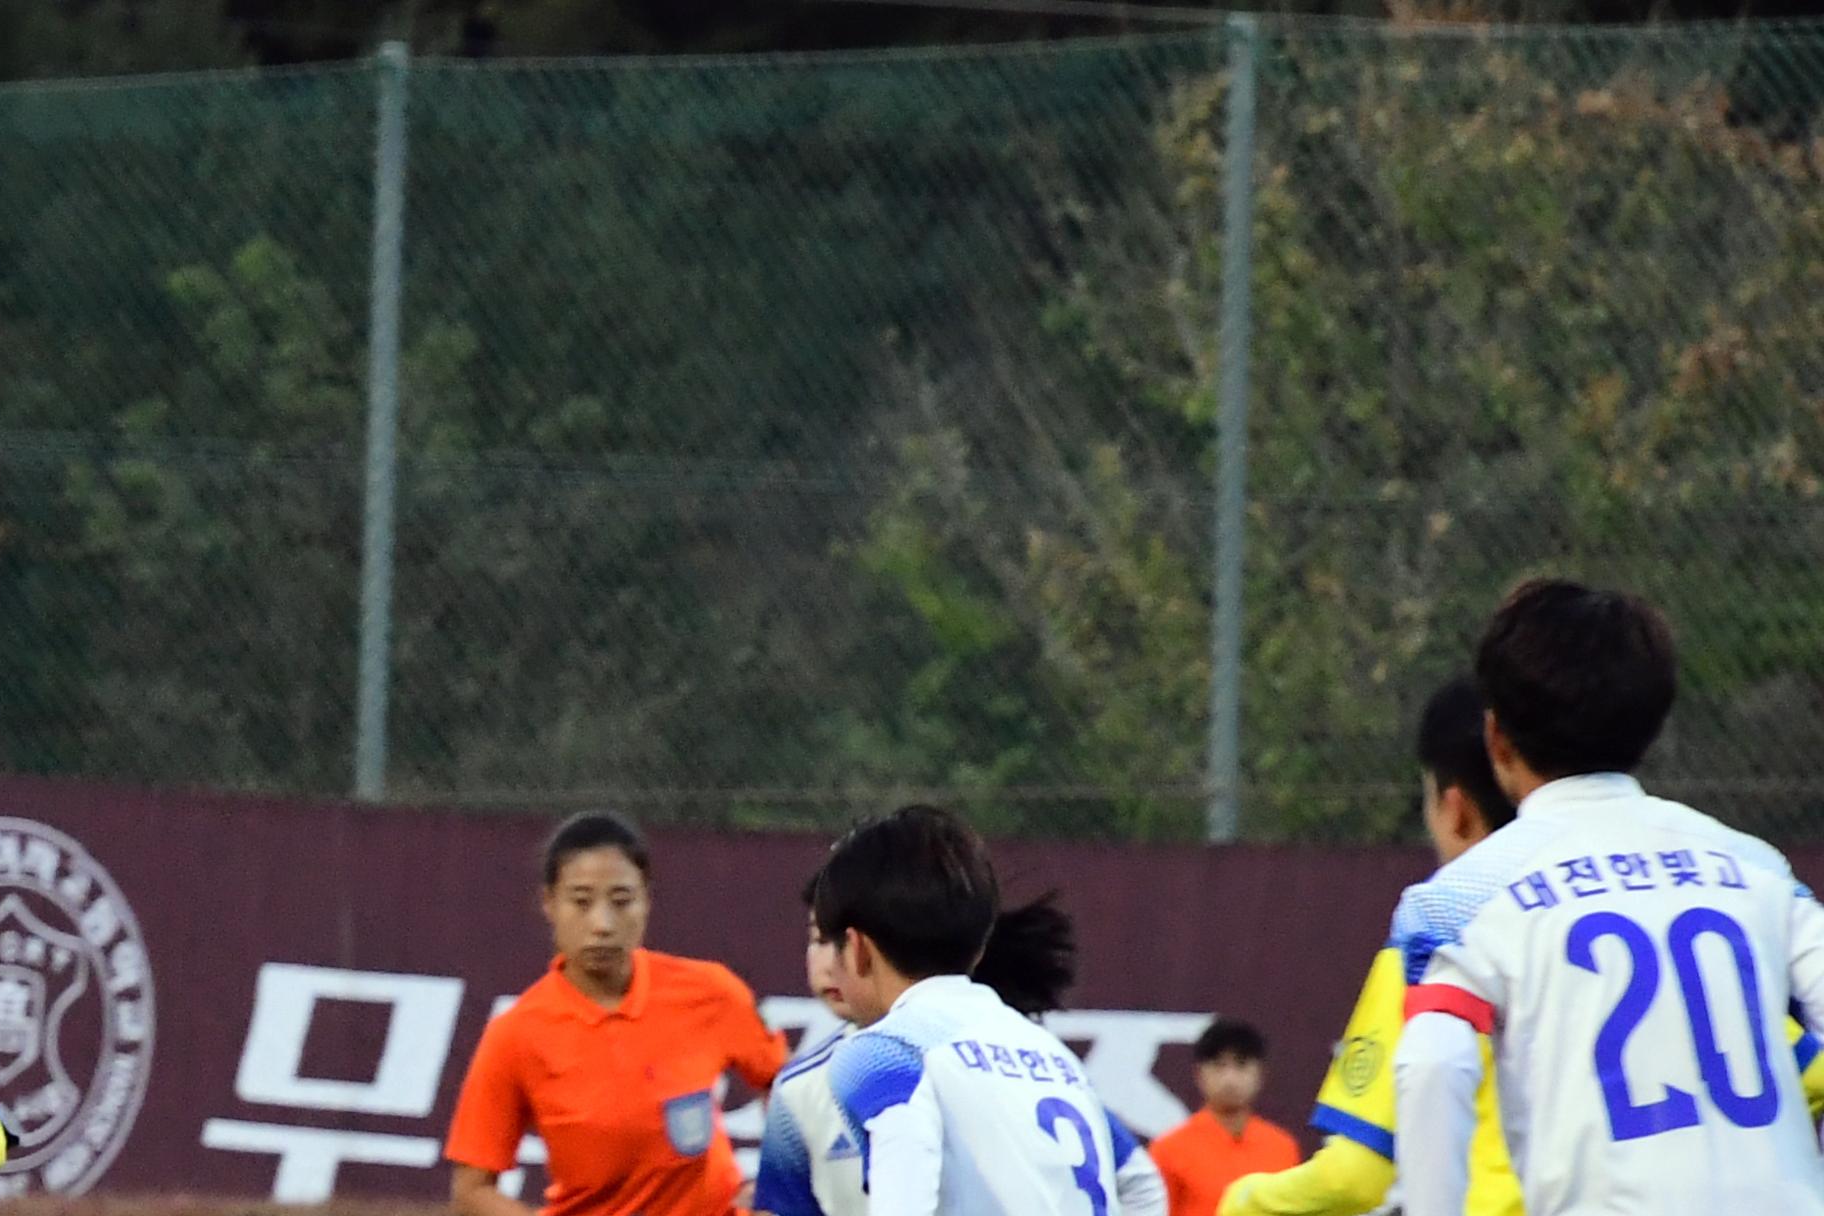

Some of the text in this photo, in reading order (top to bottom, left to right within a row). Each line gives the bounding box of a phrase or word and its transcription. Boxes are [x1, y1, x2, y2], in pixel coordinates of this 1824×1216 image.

[1508, 849, 1749, 911] 대전한빛고
[1566, 907, 1781, 1142] 20
[951, 1039, 1086, 1087] 대전한빛
